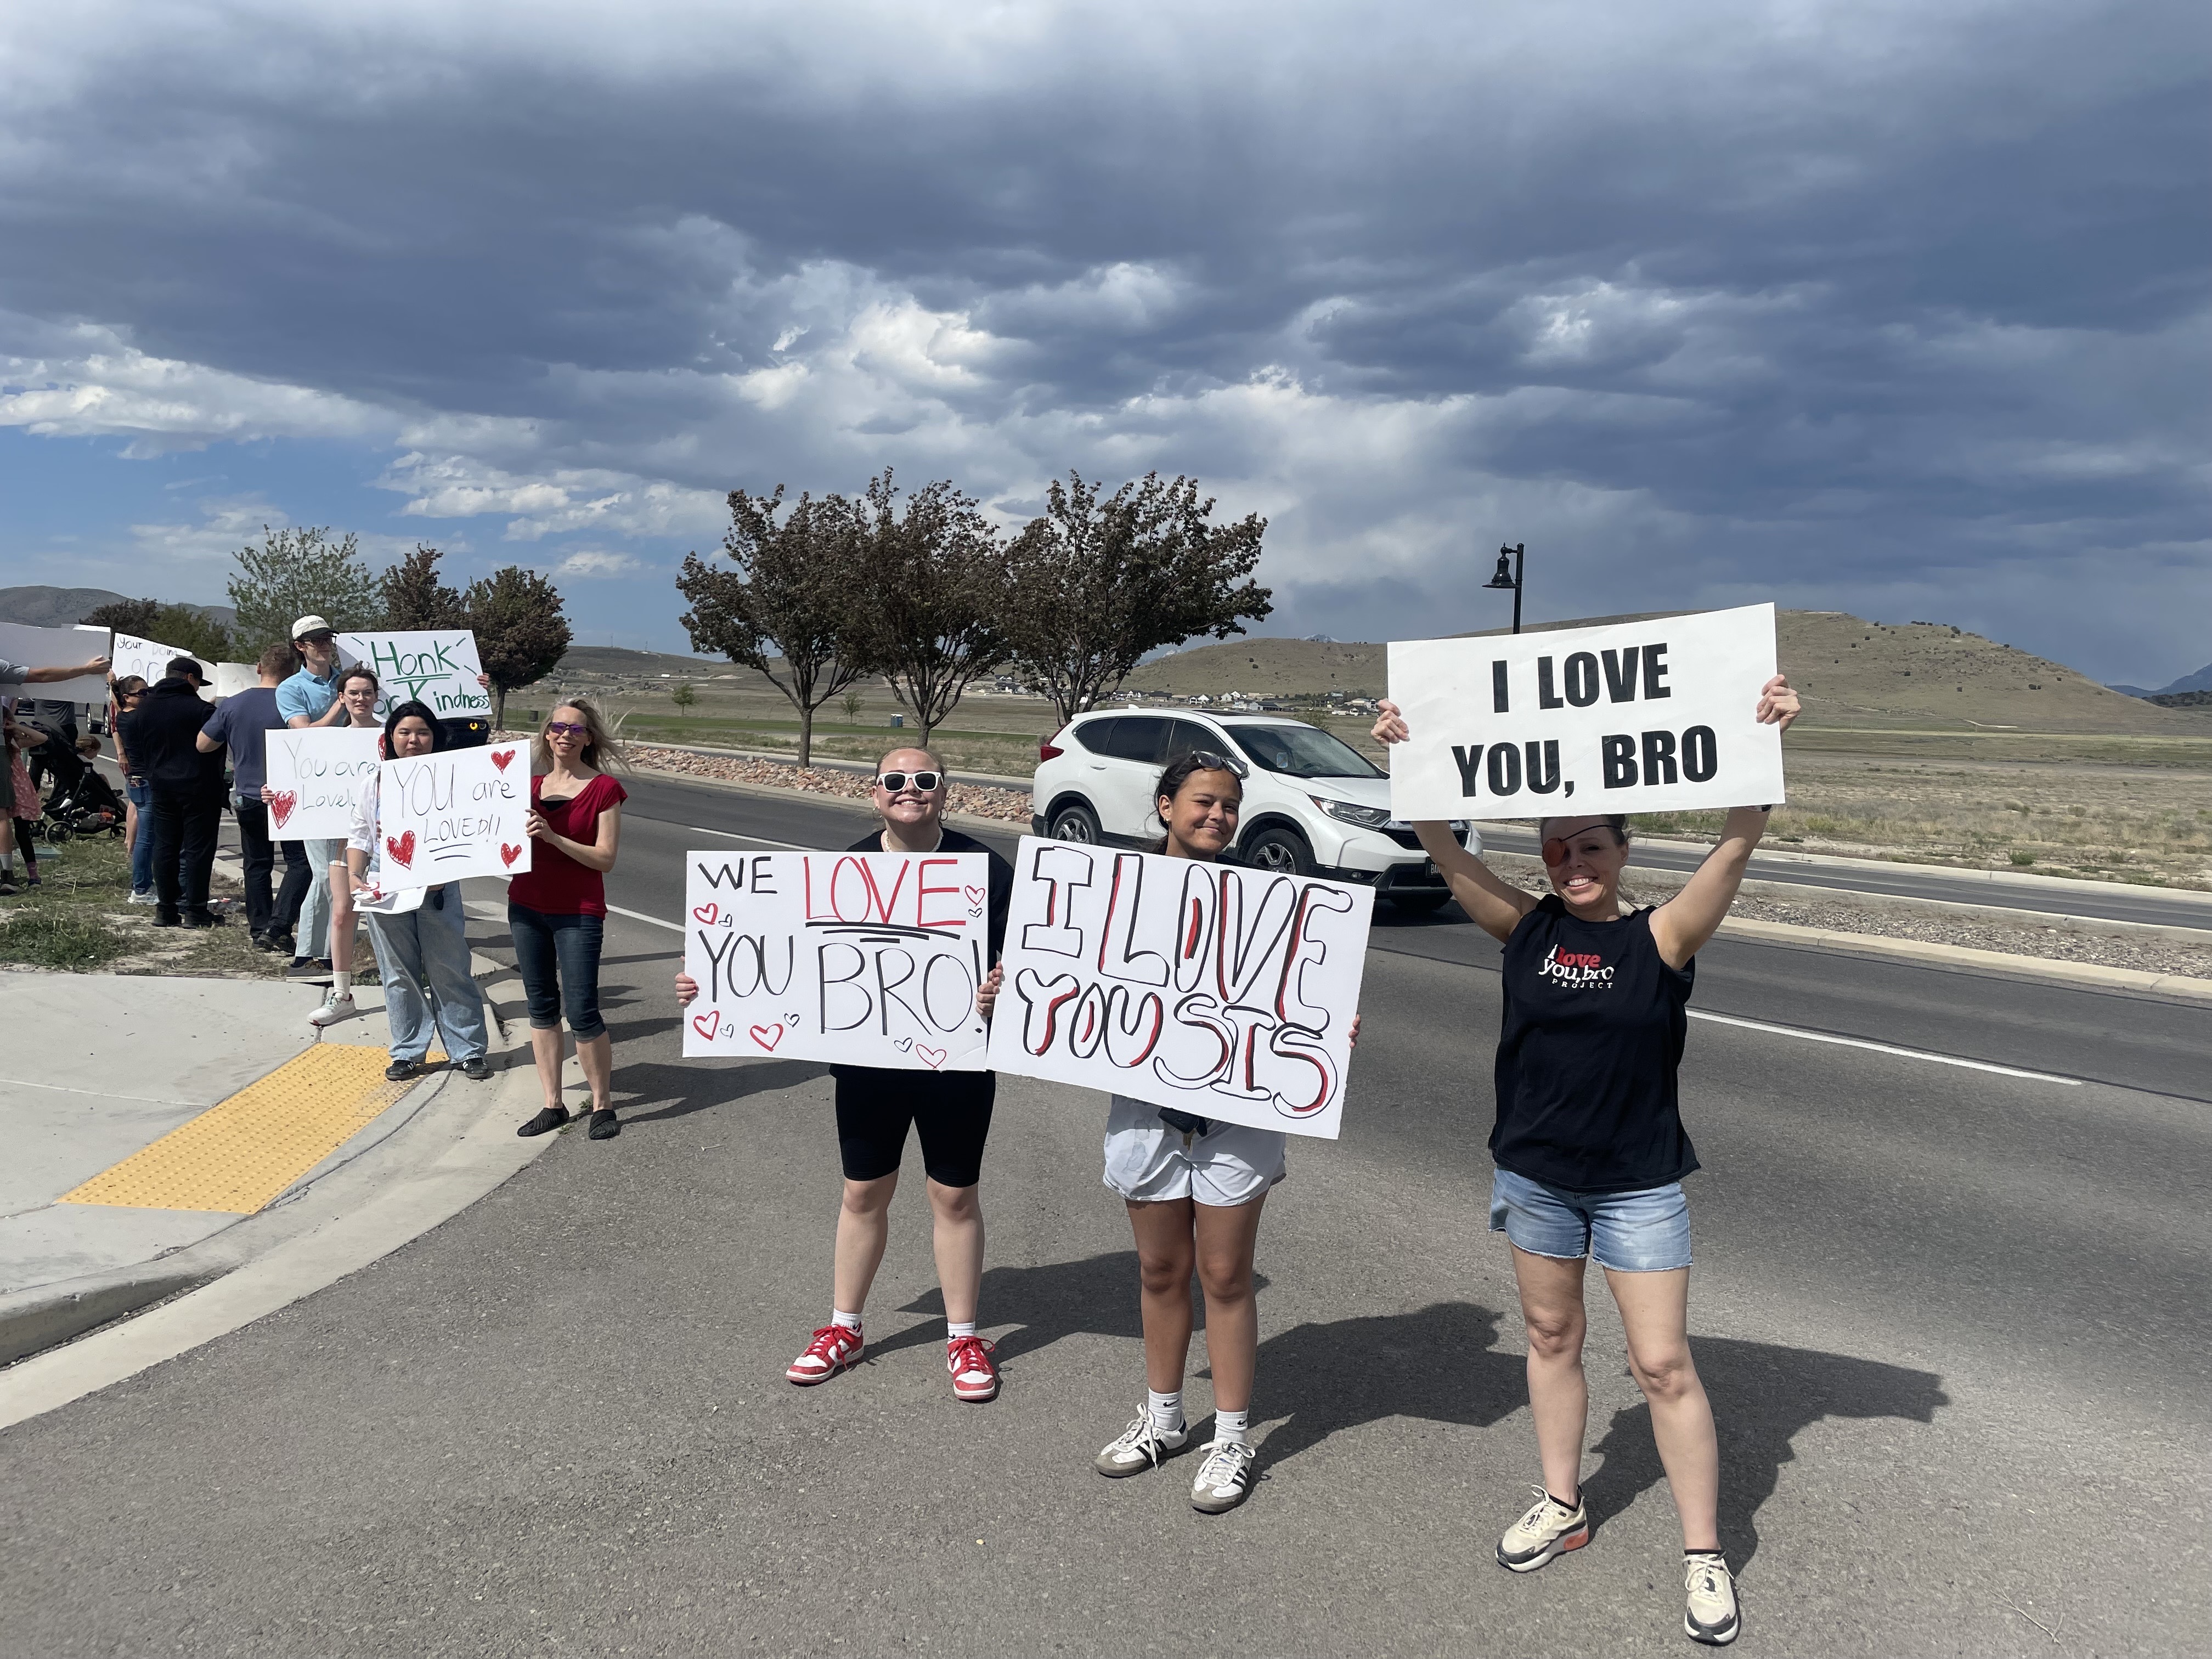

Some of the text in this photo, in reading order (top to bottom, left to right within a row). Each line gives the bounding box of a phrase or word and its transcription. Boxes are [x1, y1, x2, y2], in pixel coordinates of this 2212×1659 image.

[370, 640, 460, 678] Honk
[1492, 642, 1671, 713] I LOVE
[408, 678, 490, 712] Kindness
[284, 737, 376, 779] You are
[1451, 725, 1718, 799] YOU, BRO
[302, 783, 356, 817] Lovely
[393, 761, 516, 819] YOU are
[698, 856, 967, 928] WE LOVE
[1022, 845, 1354, 1032] I LOVE
[1557, 947, 1601, 968] love
[697, 929, 983, 1037] YOU BRO!
[1552, 979, 1612, 989] PROJECT
[1015, 968, 1339, 1119] YOU SIS
